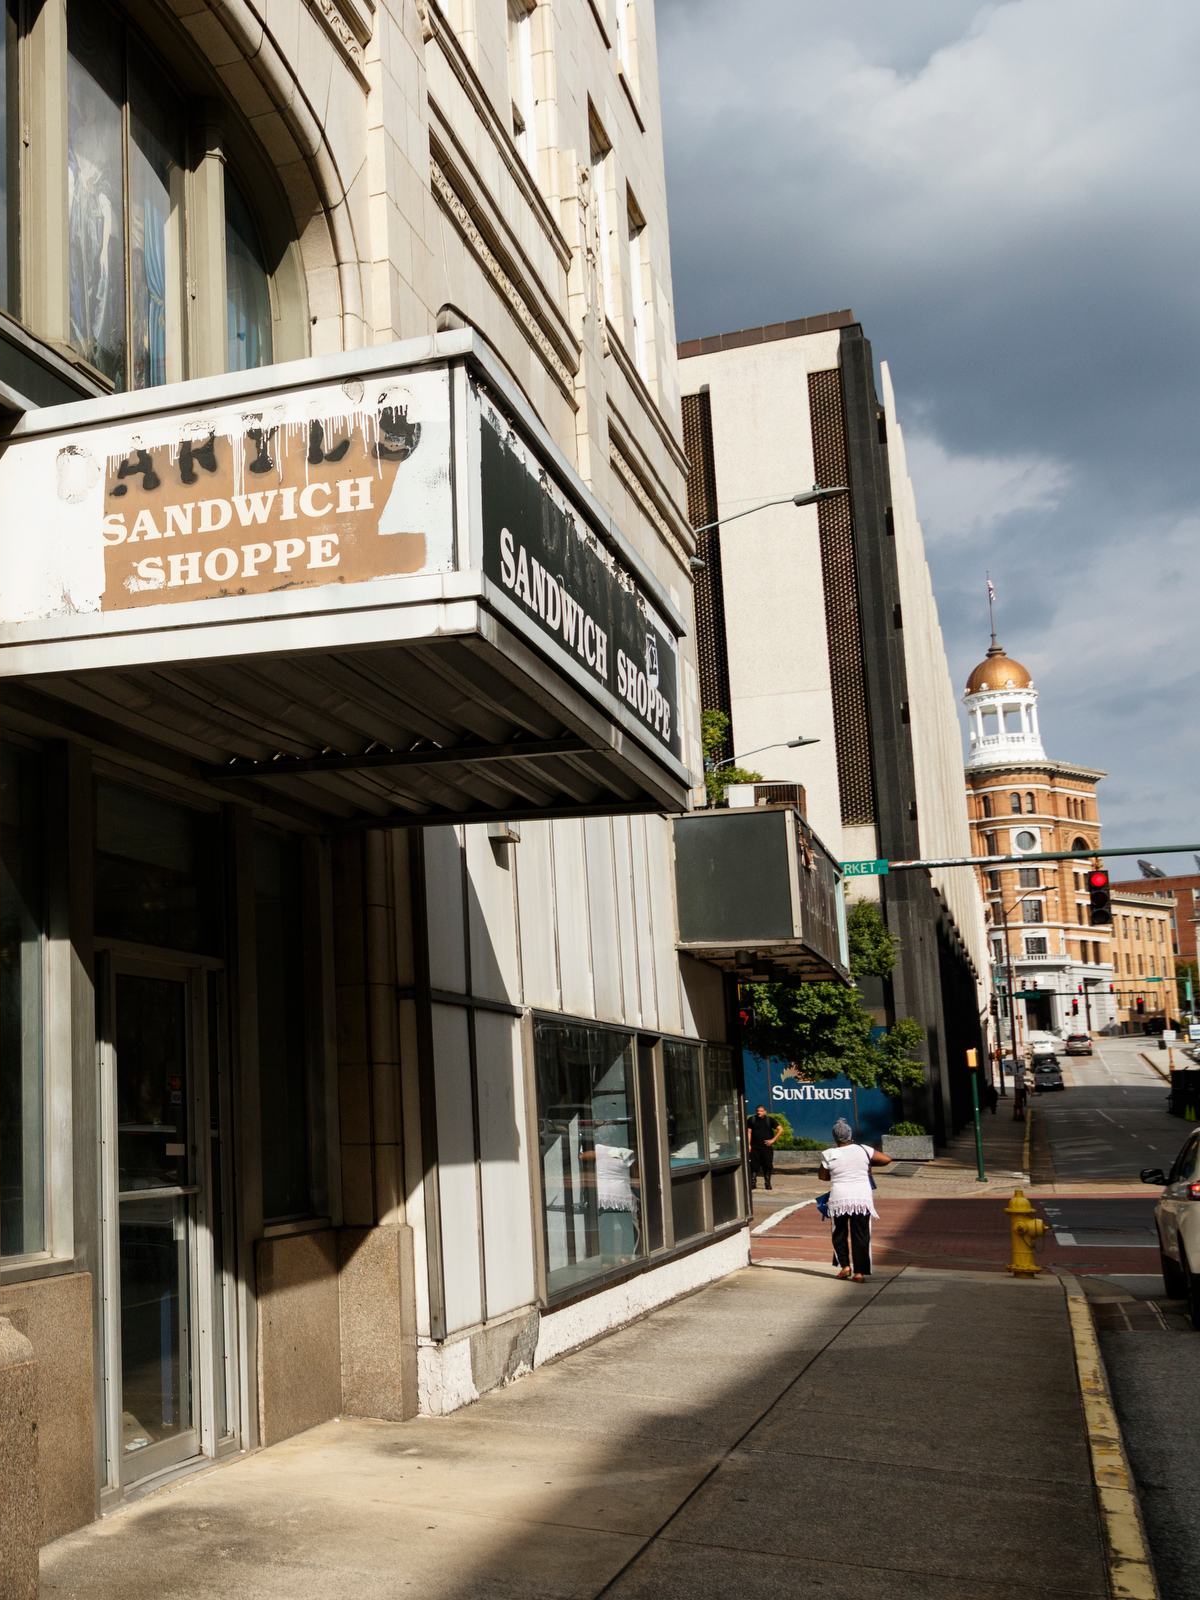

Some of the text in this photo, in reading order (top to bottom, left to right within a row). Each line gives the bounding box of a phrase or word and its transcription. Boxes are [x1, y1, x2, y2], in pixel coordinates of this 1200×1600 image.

[102, 476, 374, 547] SANDWICH
[135, 533, 340, 588] SHOPPE
[499, 526, 608, 682] SANDWICH
[616, 648, 671, 743] SHOPPE
[843, 862, 876, 875] RKET
